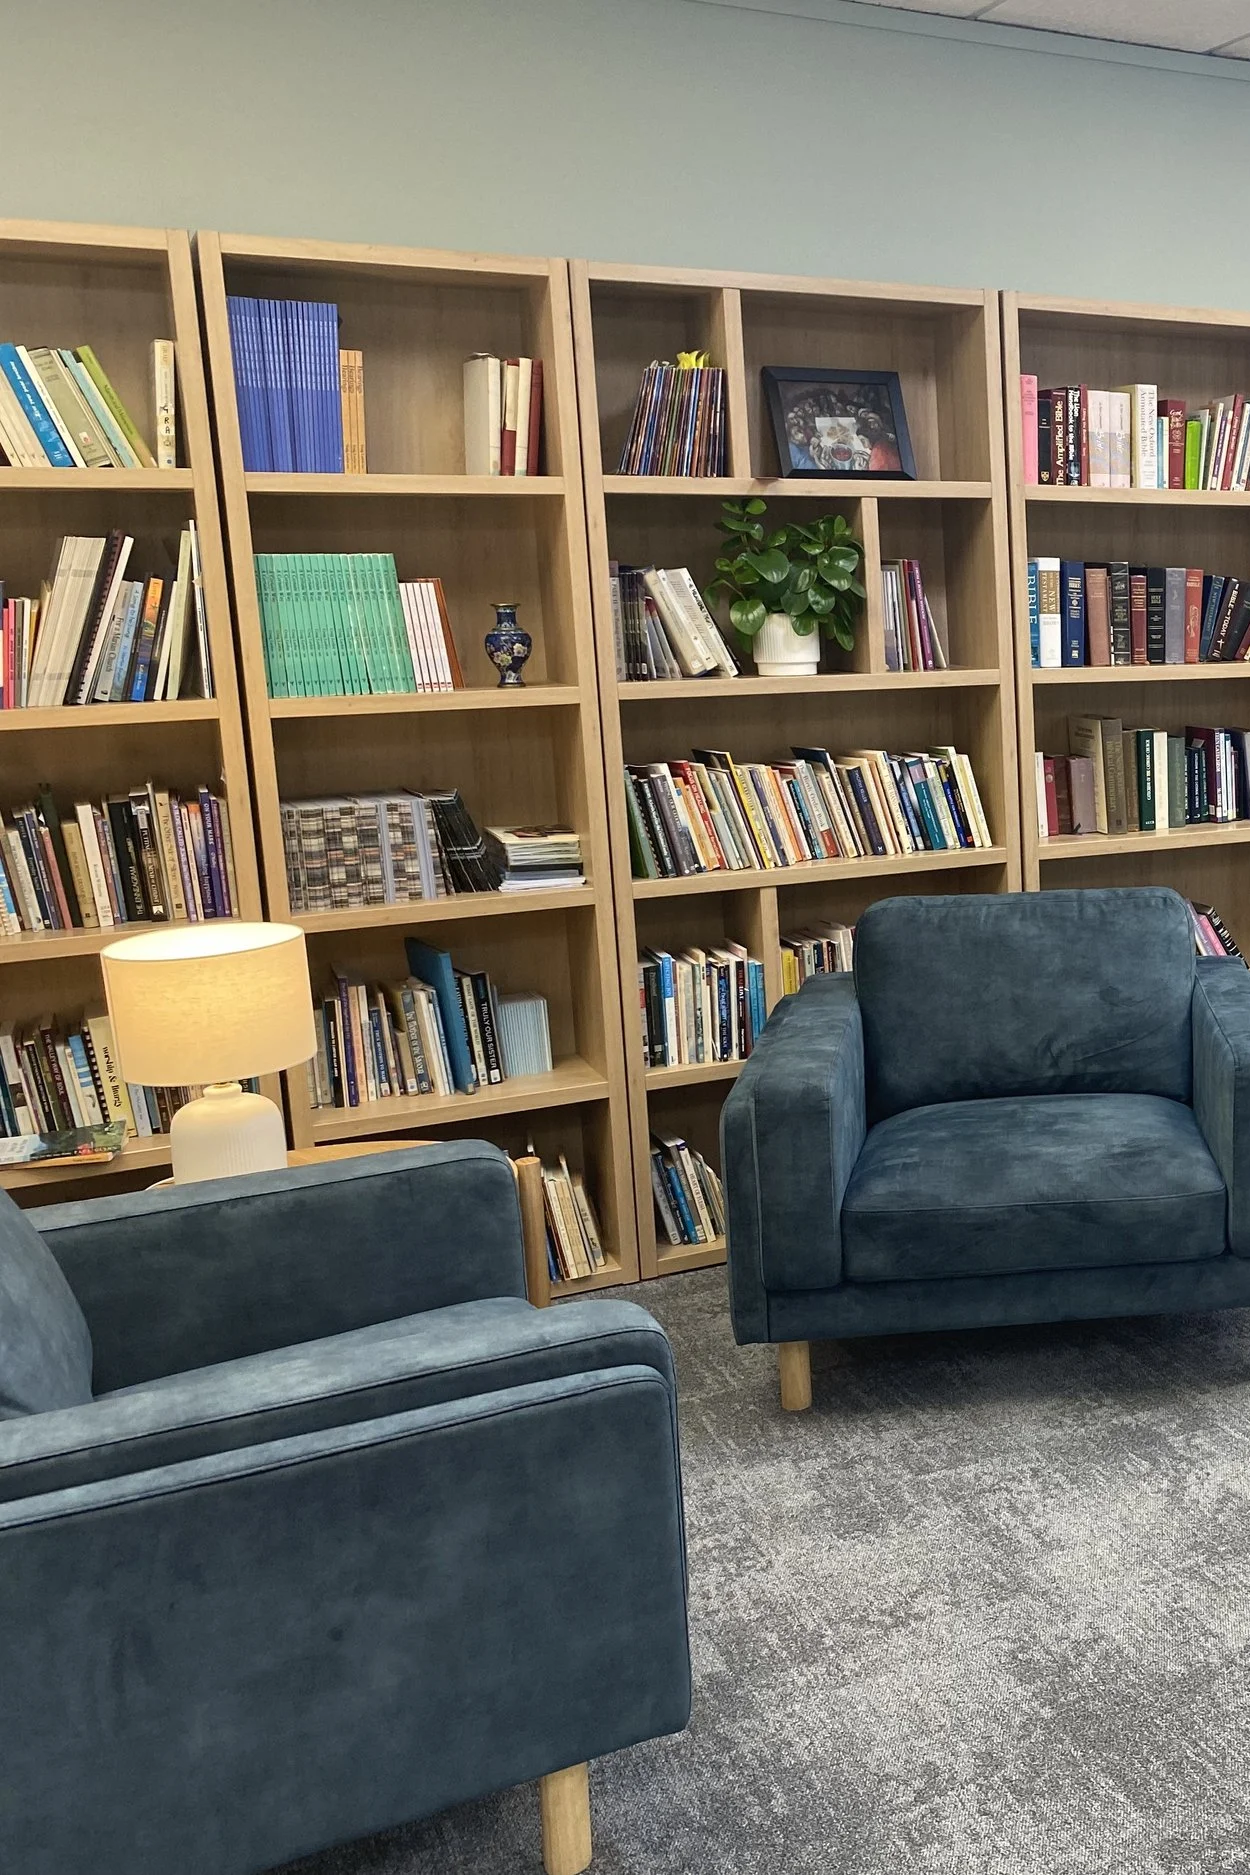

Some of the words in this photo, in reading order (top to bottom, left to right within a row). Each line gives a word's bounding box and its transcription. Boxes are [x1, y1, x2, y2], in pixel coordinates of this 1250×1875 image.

[1055, 400, 1063, 422] Bible
[1055, 425, 1063, 467] Amplified
[1027, 574, 1038, 624] BIBLE
[1228, 590, 1238, 608] BIBLE
[1220, 616, 1231, 637] TODAY
[105, 653, 117, 672] Church
[1106, 741, 1115, 766] Biblical
[686, 767, 696, 784] FOCUS
[803, 775, 814, 791] Birth
[691, 784, 699, 792] ON
[854, 769, 864, 789] TIMOTHY
[859, 789, 868, 803] KELLER
[1107, 767, 1117, 812] Commentary
[203, 803, 210, 813] ON
[693, 792, 705, 814] HEALING
[808, 792, 819, 811] Order
[815, 812, 824, 828] Book
[163, 827, 171, 843] Other
[129, 866, 141, 902] ENNEAGRAM
[202, 876, 212, 904] happiness
[481, 1002, 491, 1026] TRULY
[483, 1026, 493, 1042] OUR
[46, 1045, 56, 1062] VALLEY
[486, 1043, 498, 1069] SISTER
[689, 1173, 699, 1189] HEART
